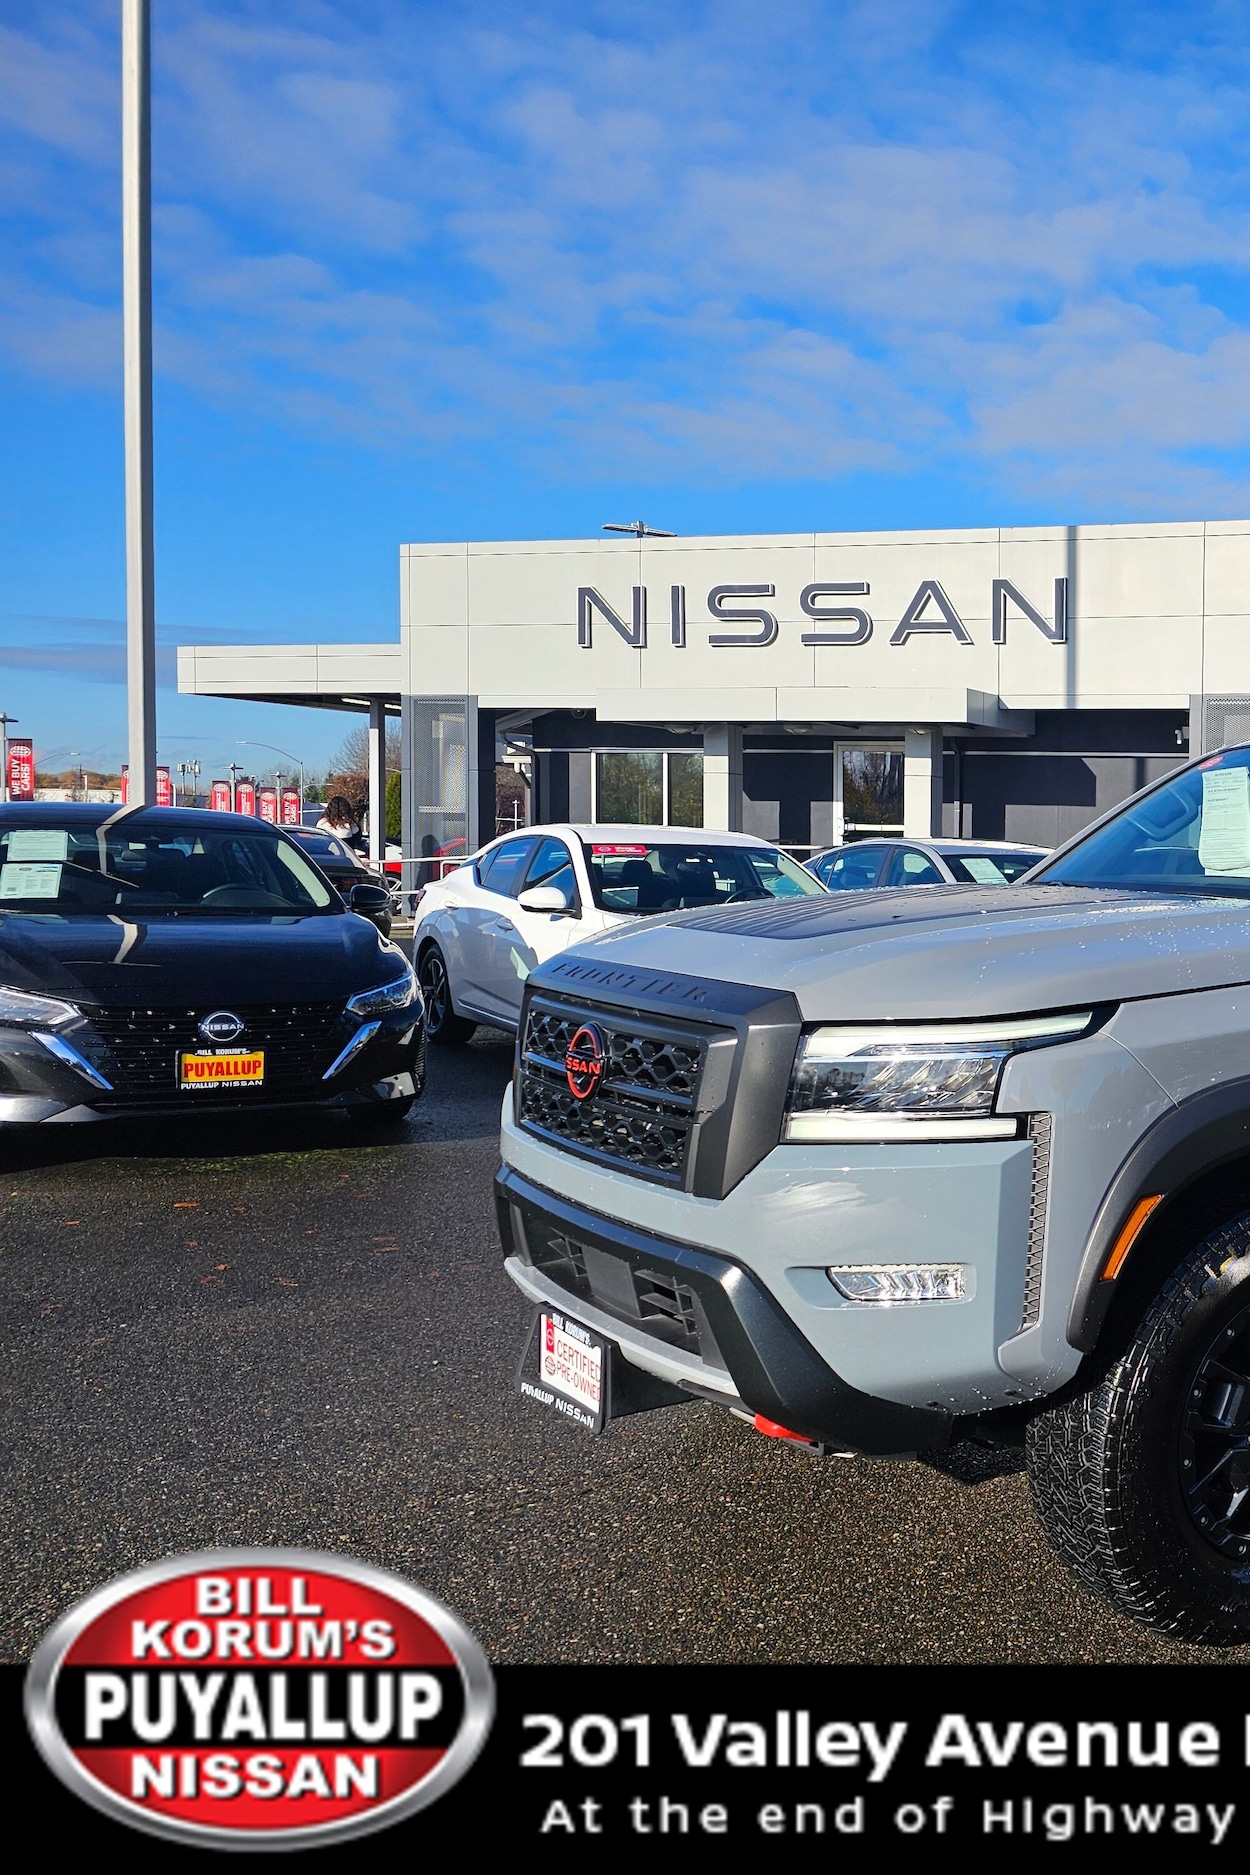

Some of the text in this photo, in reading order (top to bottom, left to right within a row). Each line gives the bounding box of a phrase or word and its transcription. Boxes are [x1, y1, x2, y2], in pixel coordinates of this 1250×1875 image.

[577, 578, 1069, 648] NISSAN
[11, 758, 20, 779] BUY
[11, 780, 20, 795] WE
[201, 1023, 244, 1031] NISSAN
[183, 1060, 261, 1078] PUYALLUP
[180, 1080, 263, 1090] PUYALLUP NISSAN
[556, 1339, 602, 1383] CERTIFIED
[521, 1382, 595, 1429] PUYALLUP NISSAN
